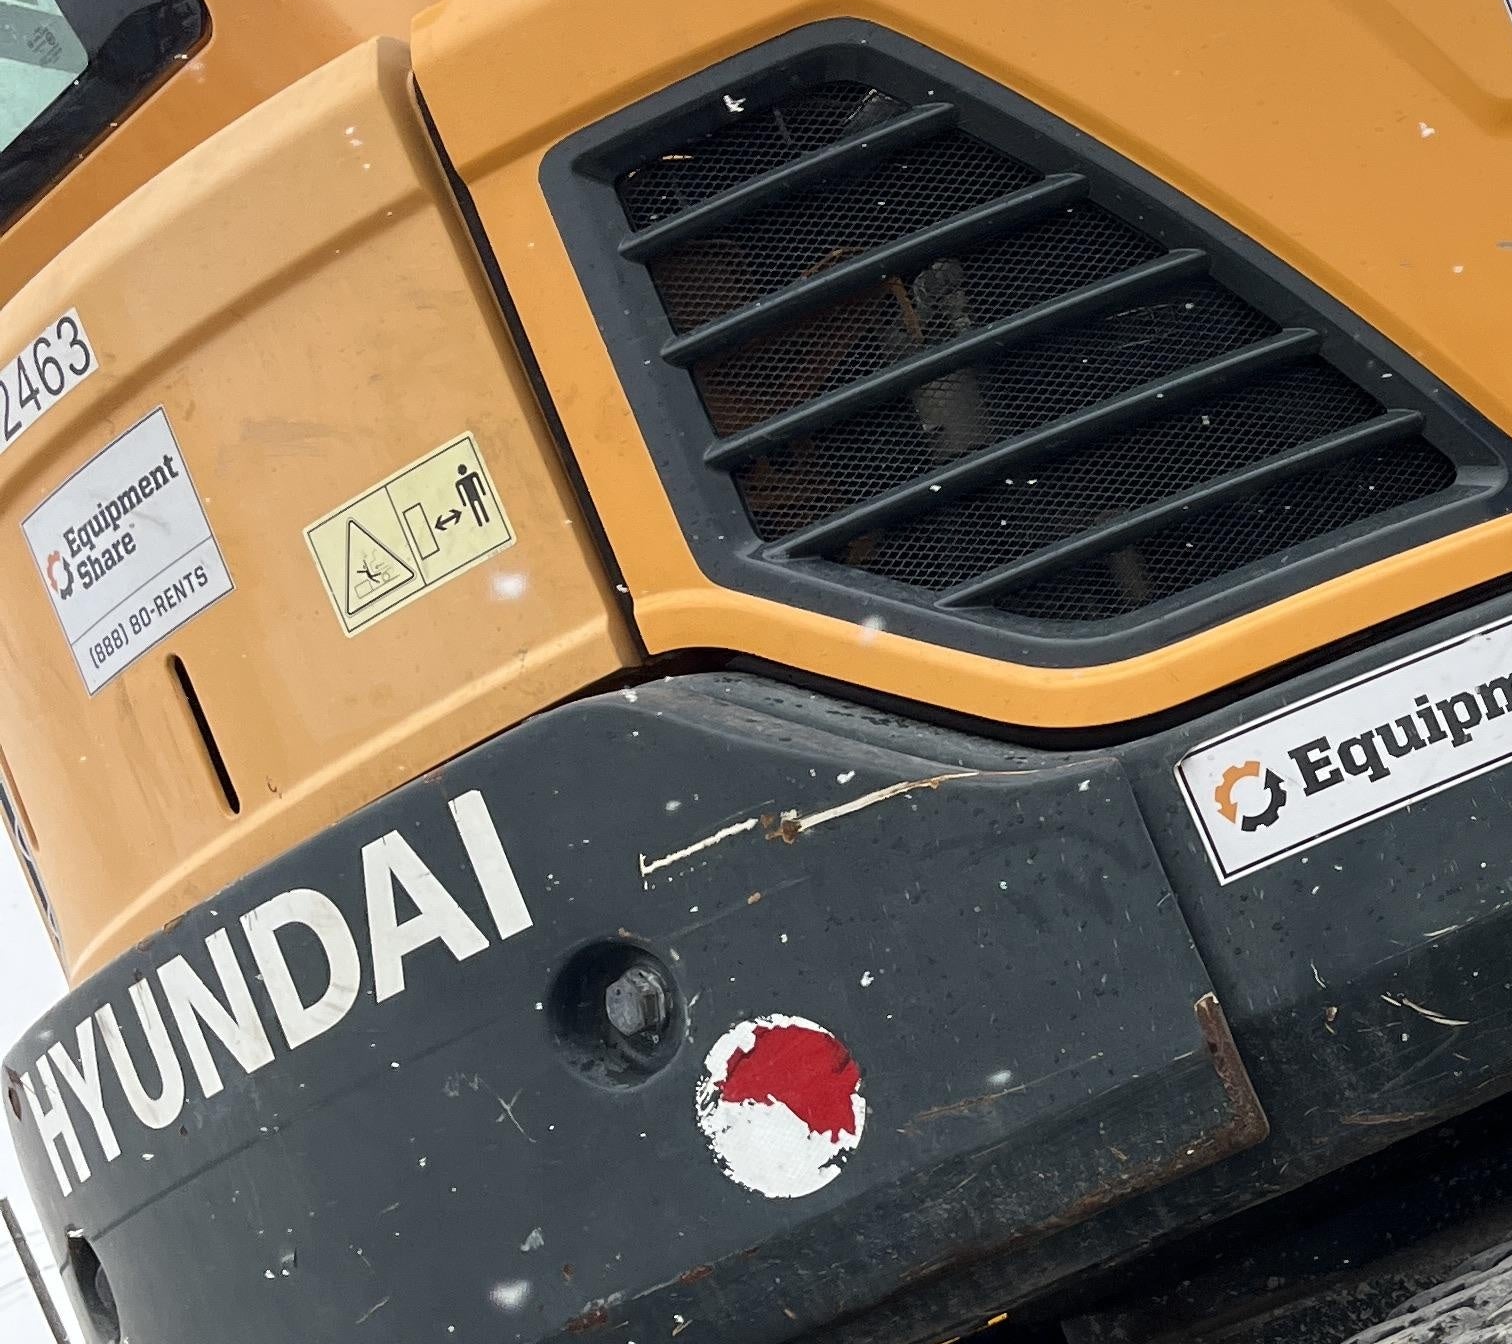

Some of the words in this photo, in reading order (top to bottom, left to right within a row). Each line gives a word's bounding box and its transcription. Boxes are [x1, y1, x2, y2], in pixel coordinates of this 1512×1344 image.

[0, 316, 91, 442] 2463
[62, 454, 179, 557] Equipment
[76, 531, 138, 591] Share
[88, 622, 128, 669] (888)
[129, 564, 208, 636] 80-RENTS
[23, 789, 534, 1197] HYUNDAI
